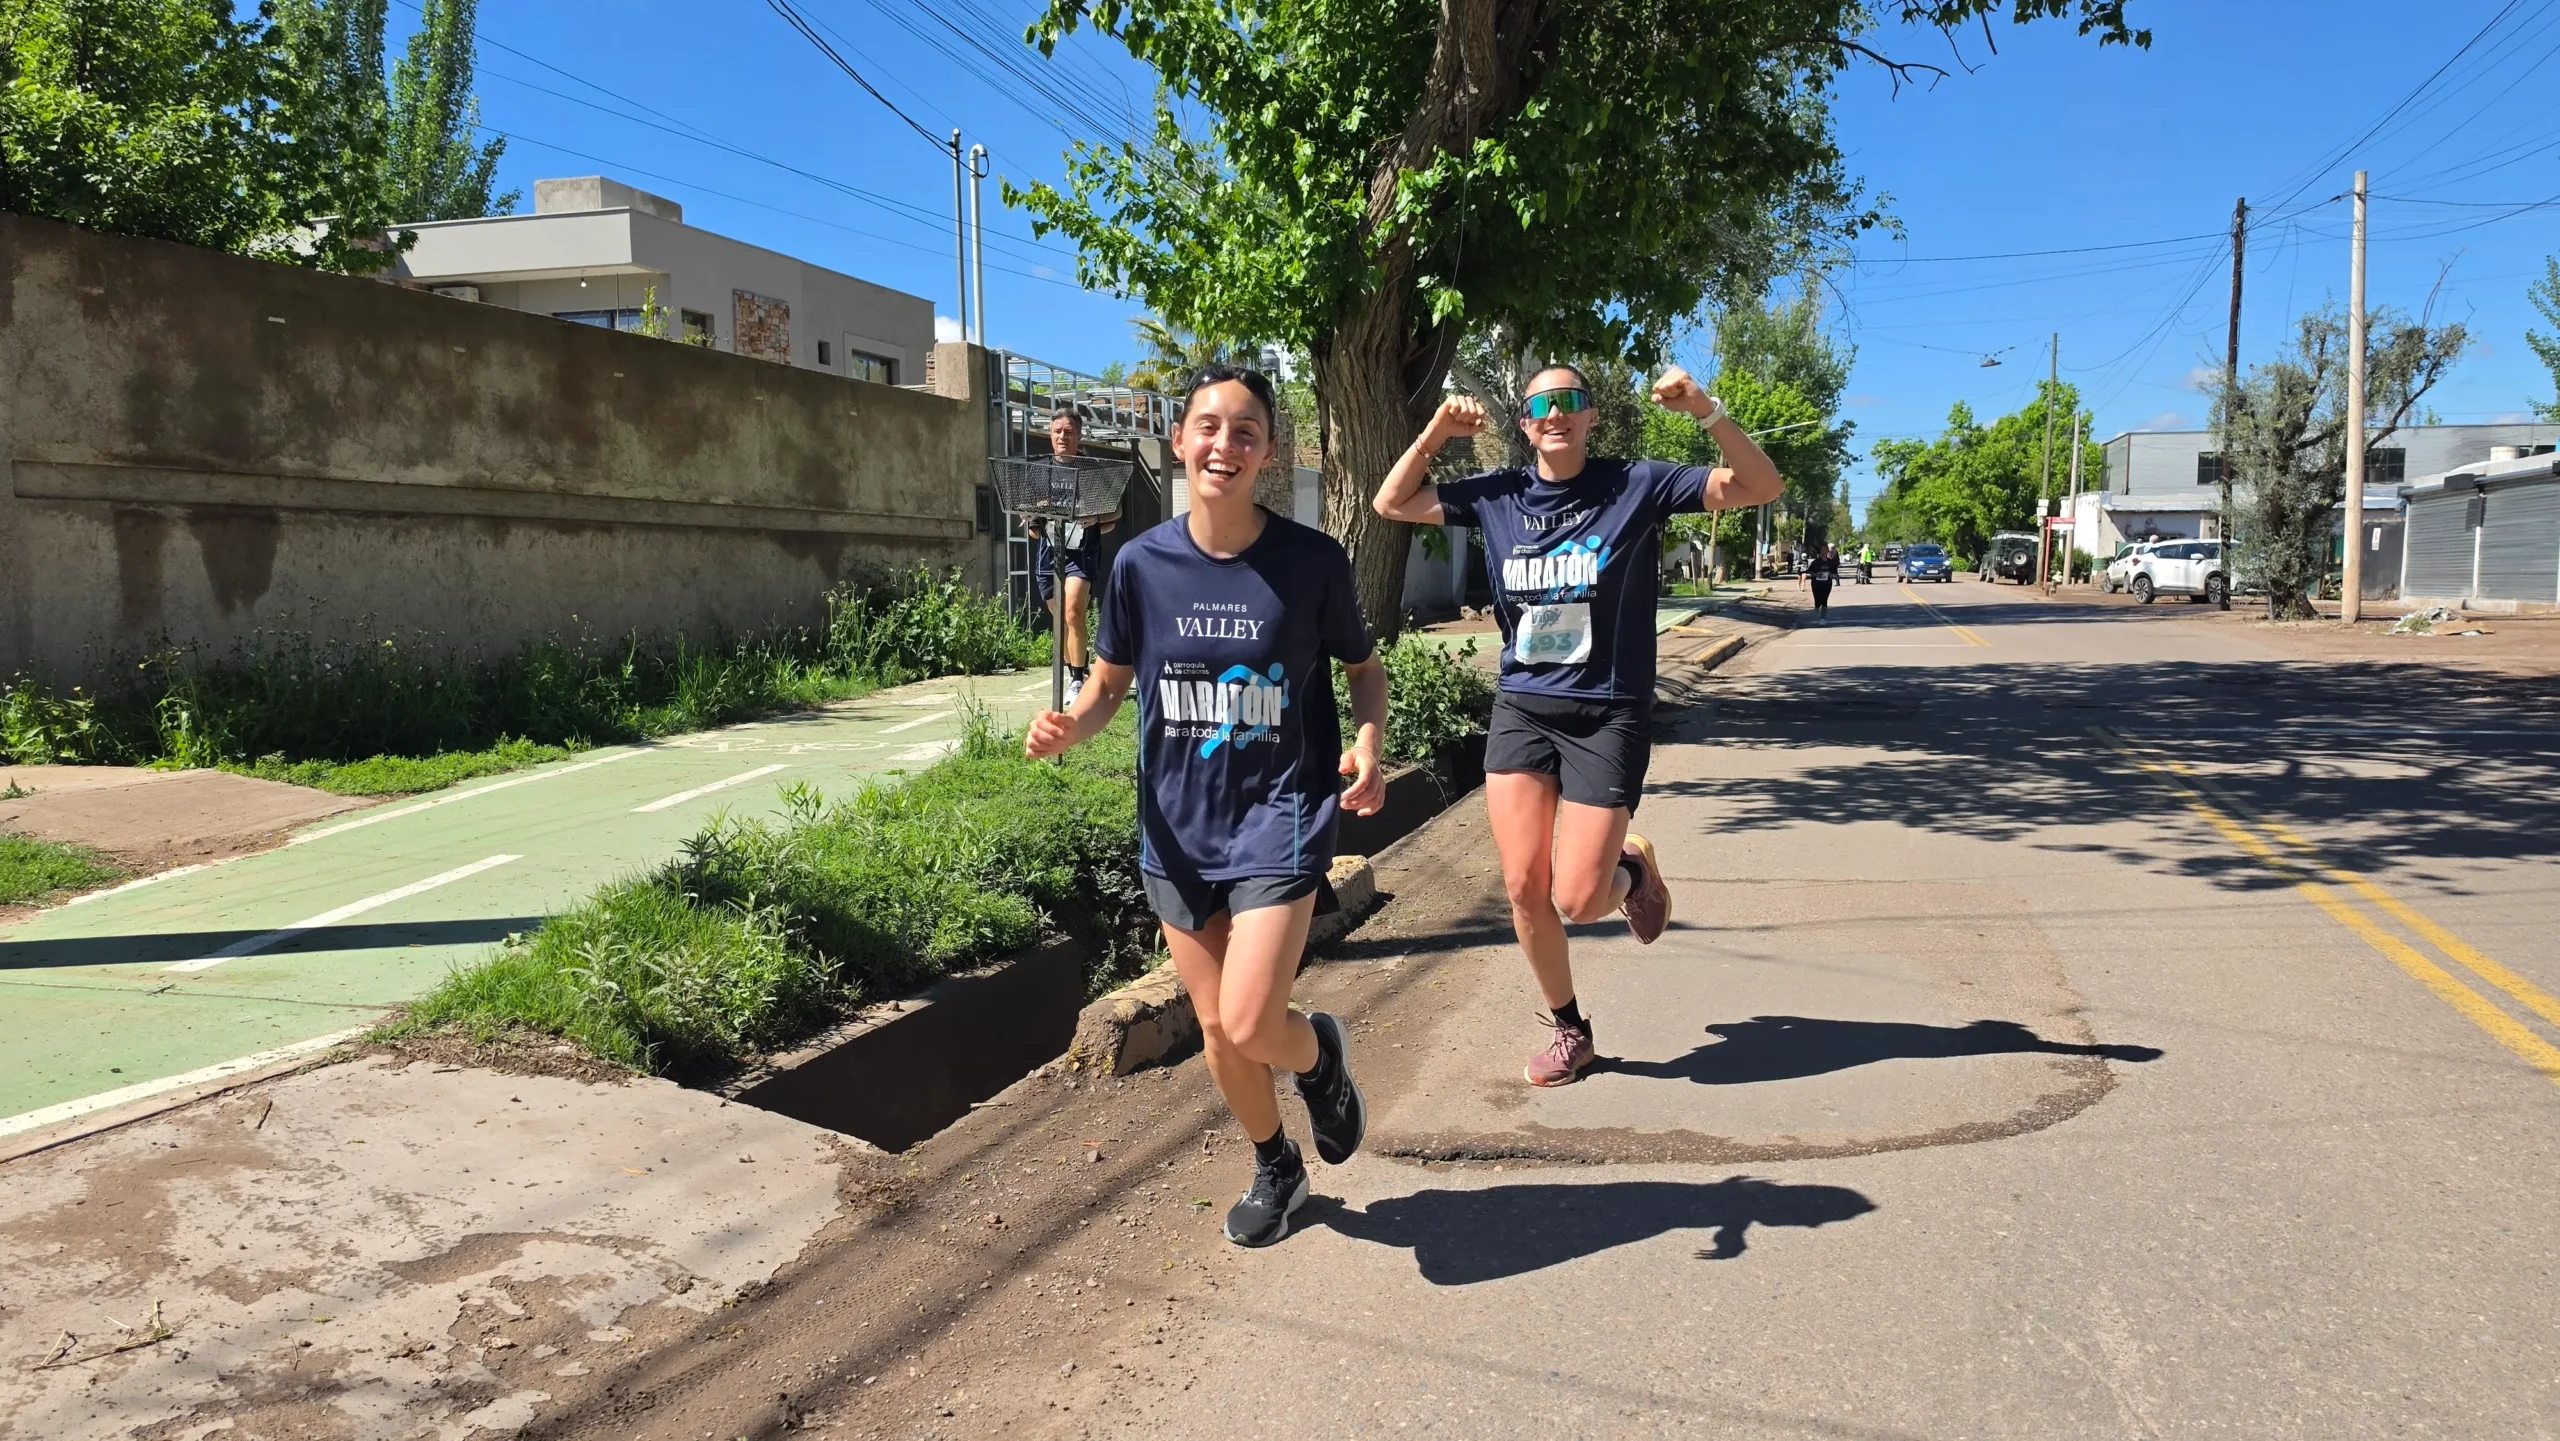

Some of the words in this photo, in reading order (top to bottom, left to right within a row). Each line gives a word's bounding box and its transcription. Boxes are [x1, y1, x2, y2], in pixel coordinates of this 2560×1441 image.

[1523, 509, 1587, 530] VALLEY
[1502, 546, 1597, 591] MARATÓN
[1506, 594, 1524, 603] para
[1524, 592, 1548, 602] toda
[1550, 591, 1559, 601] la
[1560, 588, 1597, 600] familia
[1193, 602, 1247, 612] PALMARES
[1175, 617, 1265, 640] VALLEY
[1523, 632, 1573, 654] 493
[1172, 661, 1206, 669] parroquia
[1159, 675, 1282, 726] MARATÓN
[1164, 725, 1190, 738] para
[1191, 725, 1219, 739] toda
[1222, 727, 1231, 742] la
[1232, 728, 1281, 744] familia
